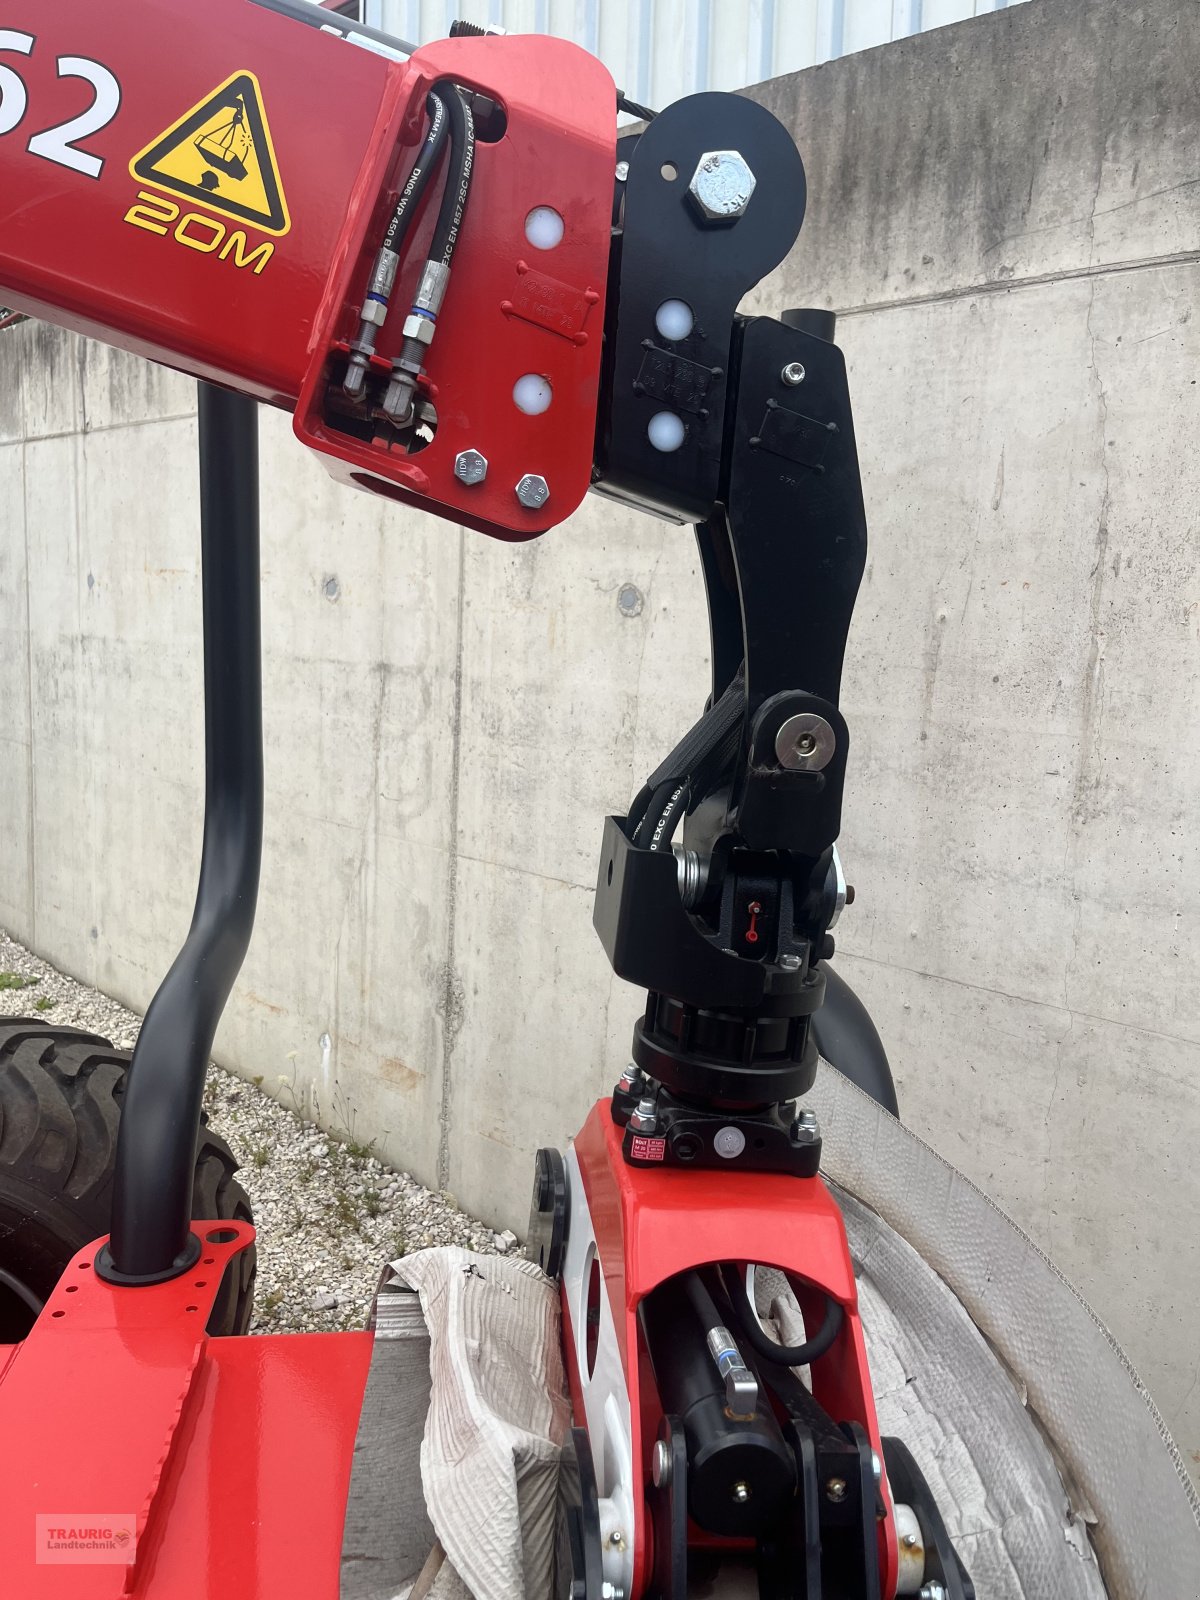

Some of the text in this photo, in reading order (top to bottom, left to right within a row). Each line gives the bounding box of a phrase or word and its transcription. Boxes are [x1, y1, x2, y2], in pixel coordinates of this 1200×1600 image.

[463, 145, 474, 179] MSHA
[404, 167, 421, 196] DN06
[458, 180, 469, 204] 2SC
[397, 198, 408, 216] WP
[453, 205, 463, 225] 857
[122, 190, 275, 275] 20M
[387, 216, 399, 236] 450
[448, 226, 458, 243] EN
[520, 478, 532, 497] HDW
[652, 819, 666, 841] EXC
[662, 802, 674, 817] EN
